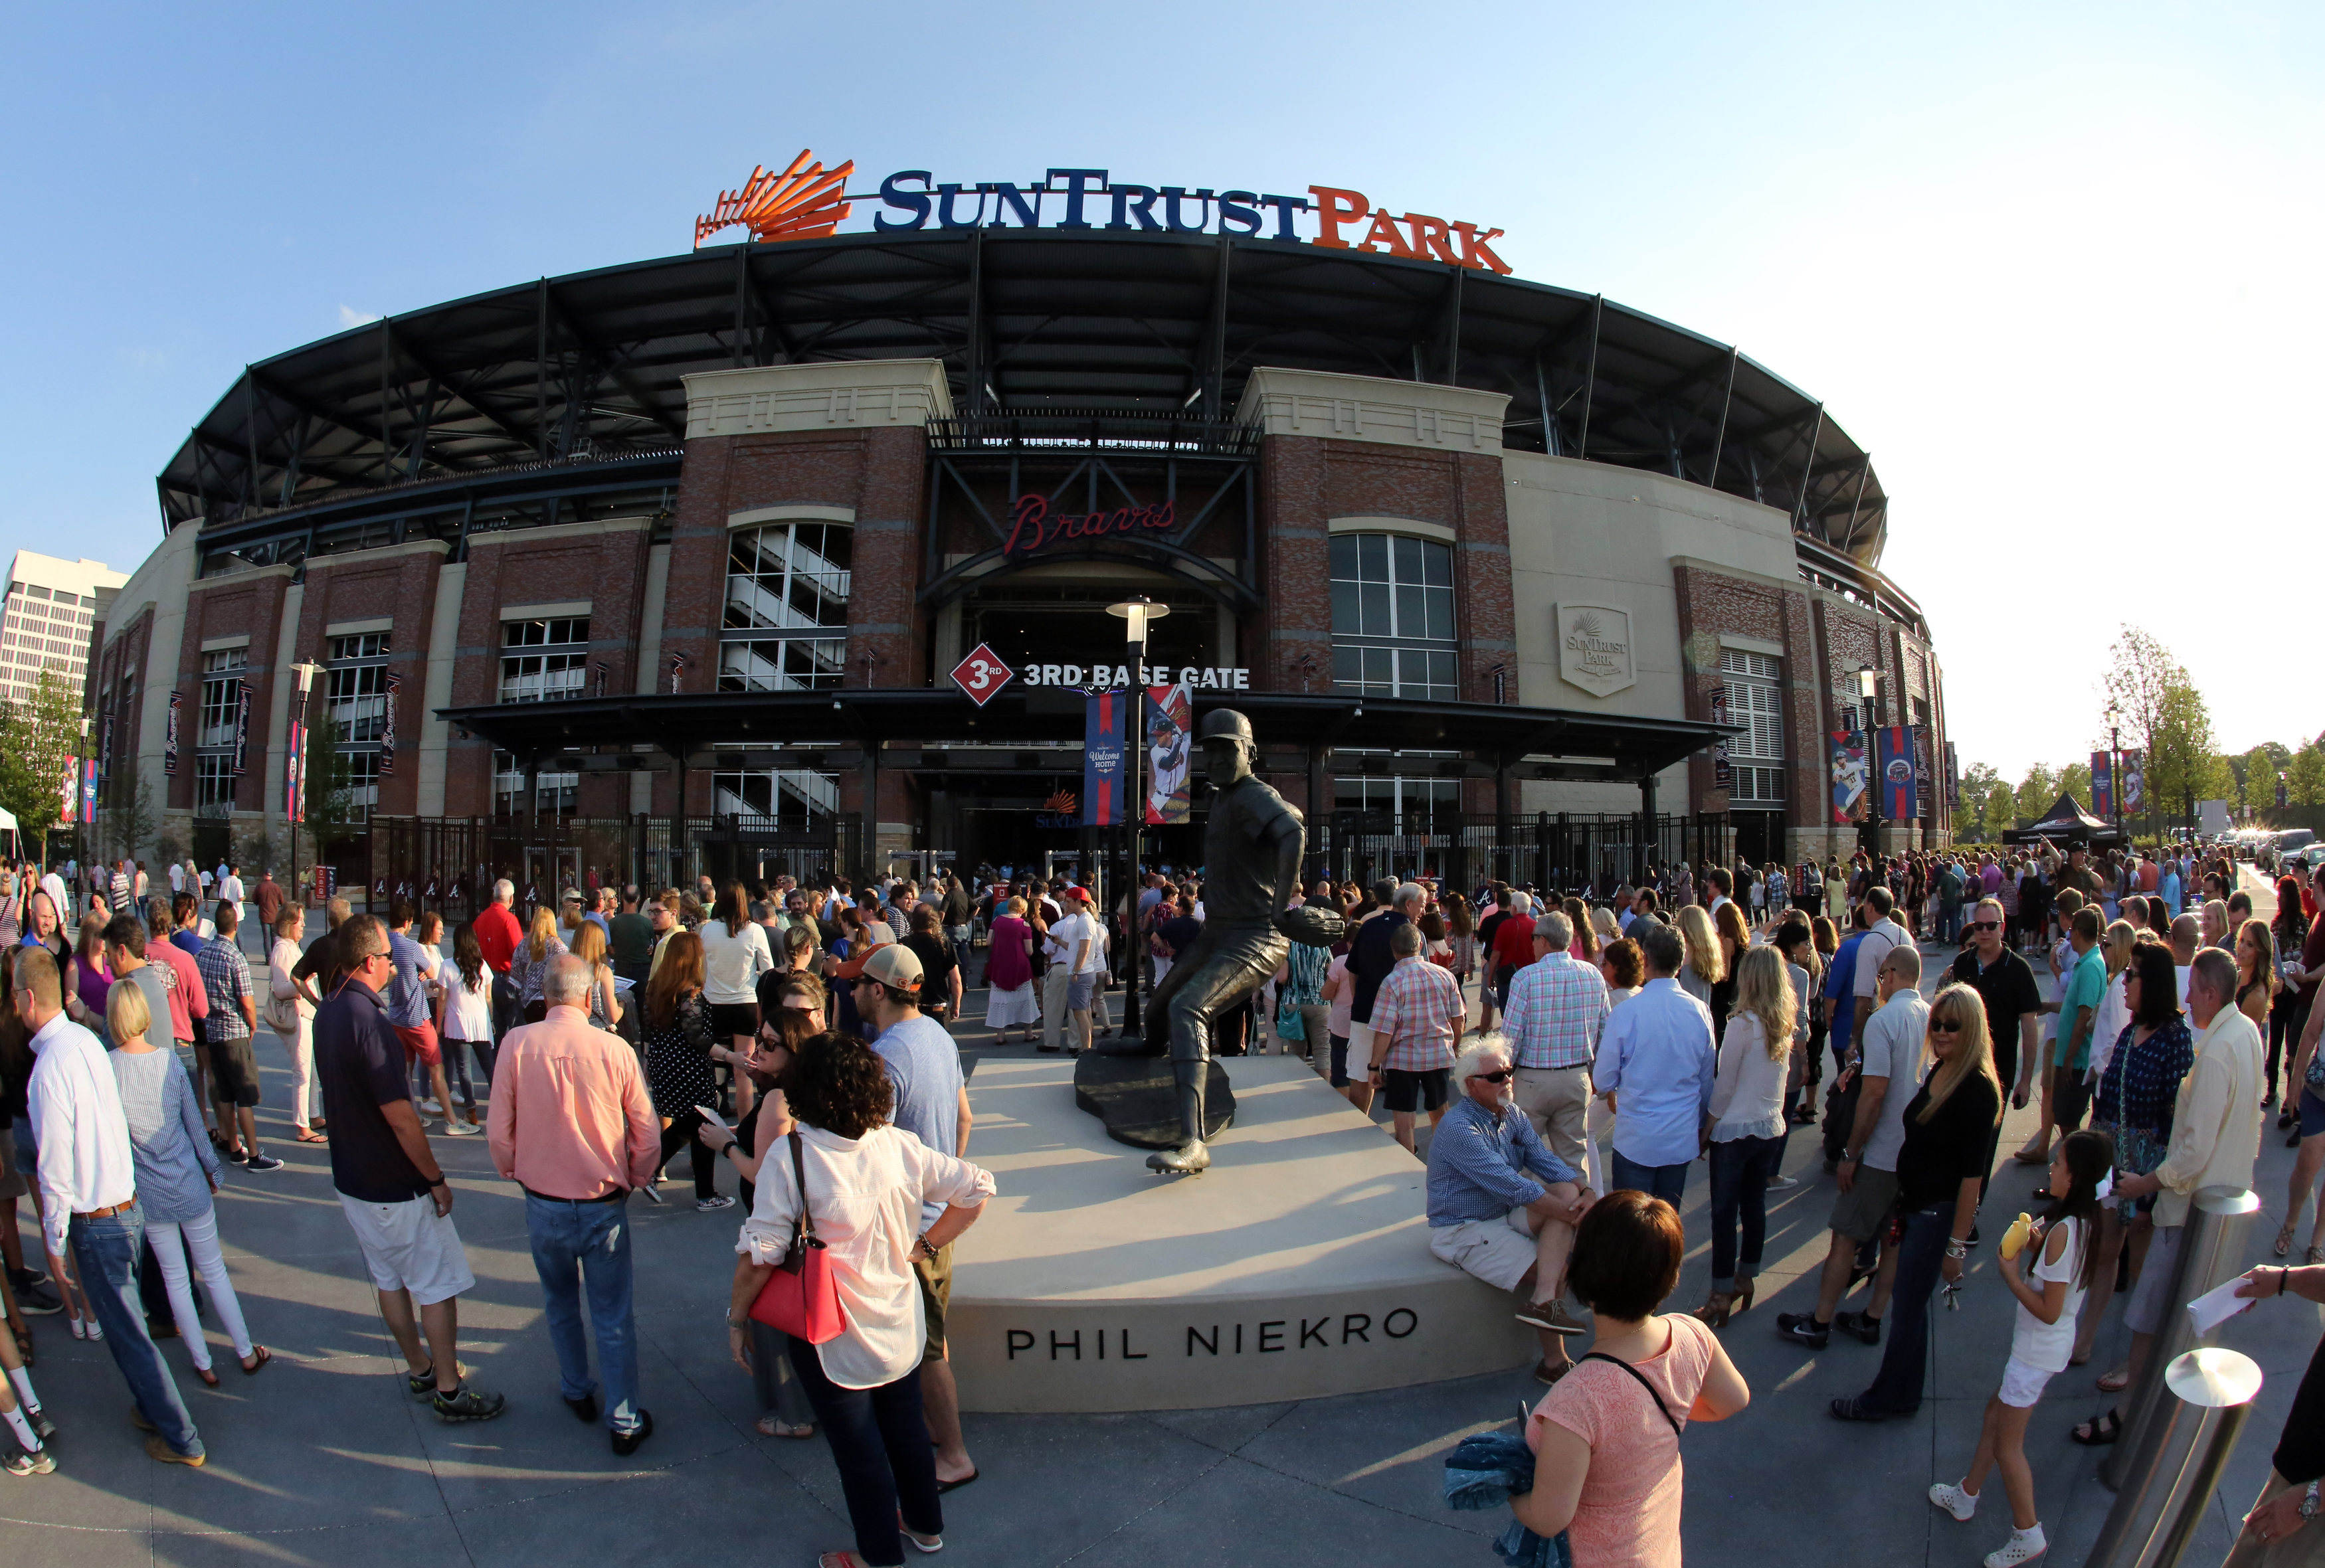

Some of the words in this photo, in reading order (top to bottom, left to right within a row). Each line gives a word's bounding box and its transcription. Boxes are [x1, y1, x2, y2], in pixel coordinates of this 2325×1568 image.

[1004, 493, 1176, 555] Braves
[1023, 664, 1082, 686] 3RD
[1093, 665, 1169, 687] BASE
[1180, 666, 1250, 689] GATE
[382, 692, 395, 750] Braves
[164, 707, 178, 755] Braves
[1089, 750, 1121, 762] Welcome
[1916, 739, 1929, 781] Braves
[1036, 812, 1085, 829] SUNTR
[376, 880, 385, 893] A
[396, 881, 405, 895] A
[426, 882, 435, 895] A
[449, 884, 458, 897] A
[525, 887, 536, 901] A
[1581, 885, 1592, 899] A
[1477, 889, 1490, 905] A
[1007, 1329, 1147, 1360] PHIL
[1187, 1308, 1418, 1356] NIEKRO
